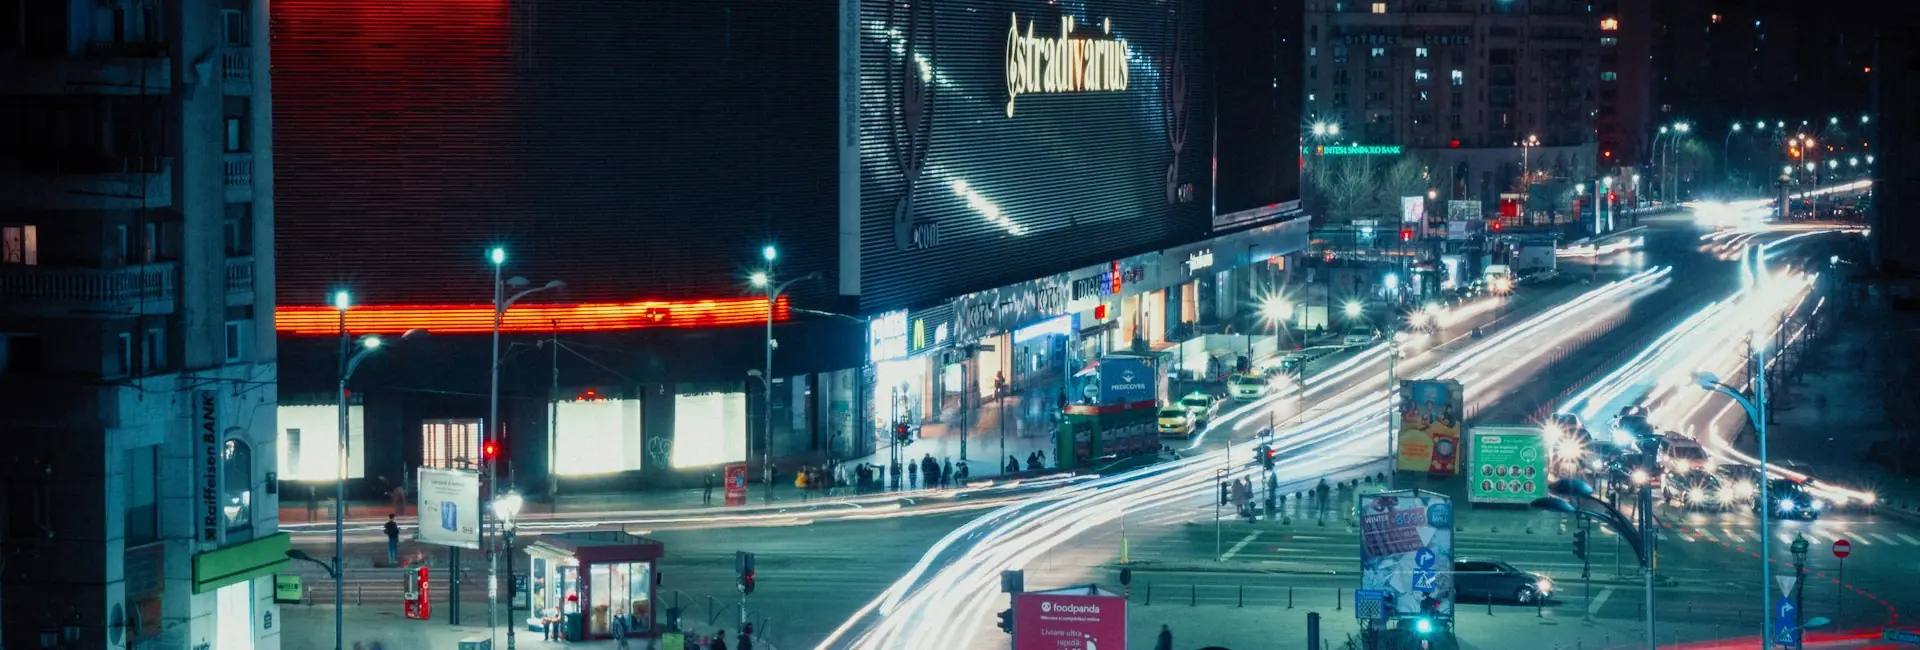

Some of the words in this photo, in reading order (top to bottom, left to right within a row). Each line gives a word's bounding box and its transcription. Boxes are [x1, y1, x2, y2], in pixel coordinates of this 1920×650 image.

[1111, 383, 1146, 391] MEDICOVER
[1053, 603, 1100, 614] foodpanda
[1066, 629, 1082, 637] ultra
